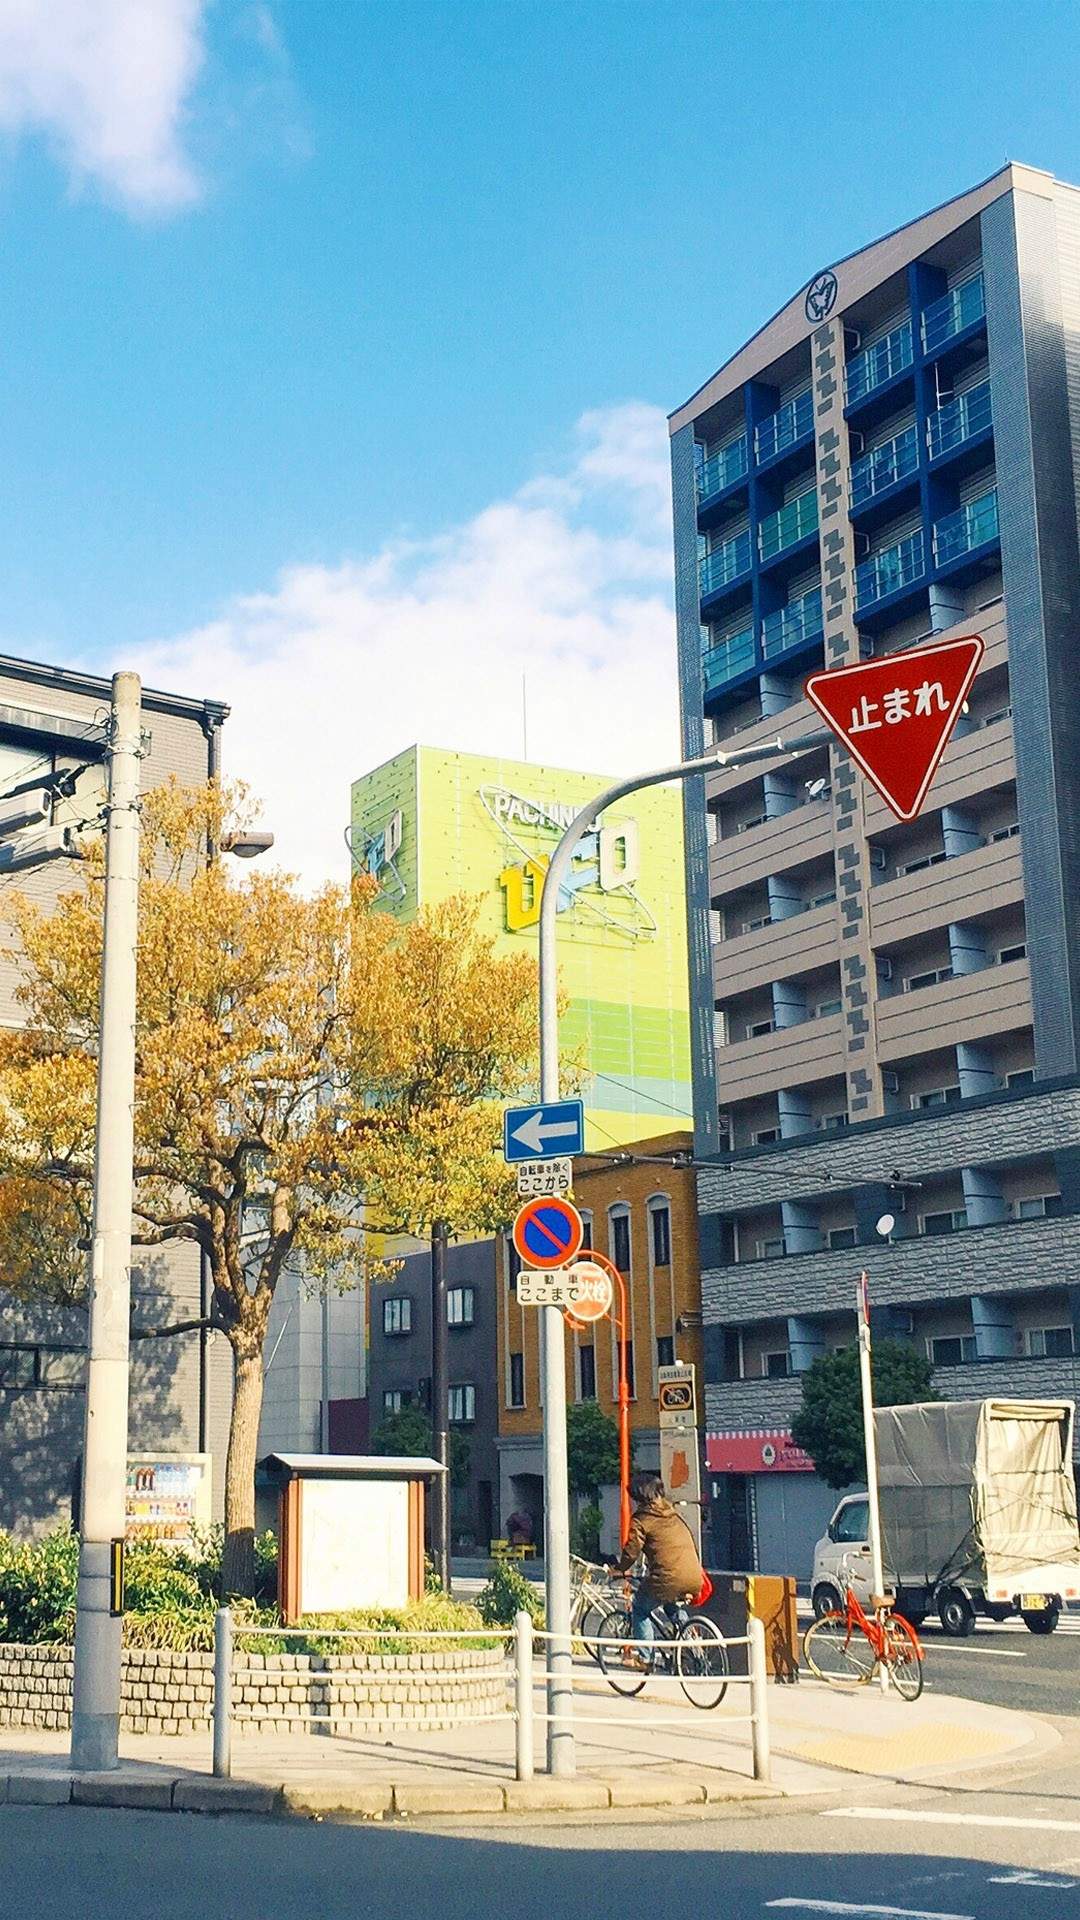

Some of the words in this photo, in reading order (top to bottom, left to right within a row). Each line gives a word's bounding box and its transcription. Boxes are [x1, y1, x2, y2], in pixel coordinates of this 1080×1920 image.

[848, 681, 950, 734] 止まれ
[519, 1163, 567, 1176] 自転車を除く
[519, 1175, 569, 1192] ここから
[520, 1275, 578, 1285] 自動車
[520, 1288, 579, 1301] ここまで
